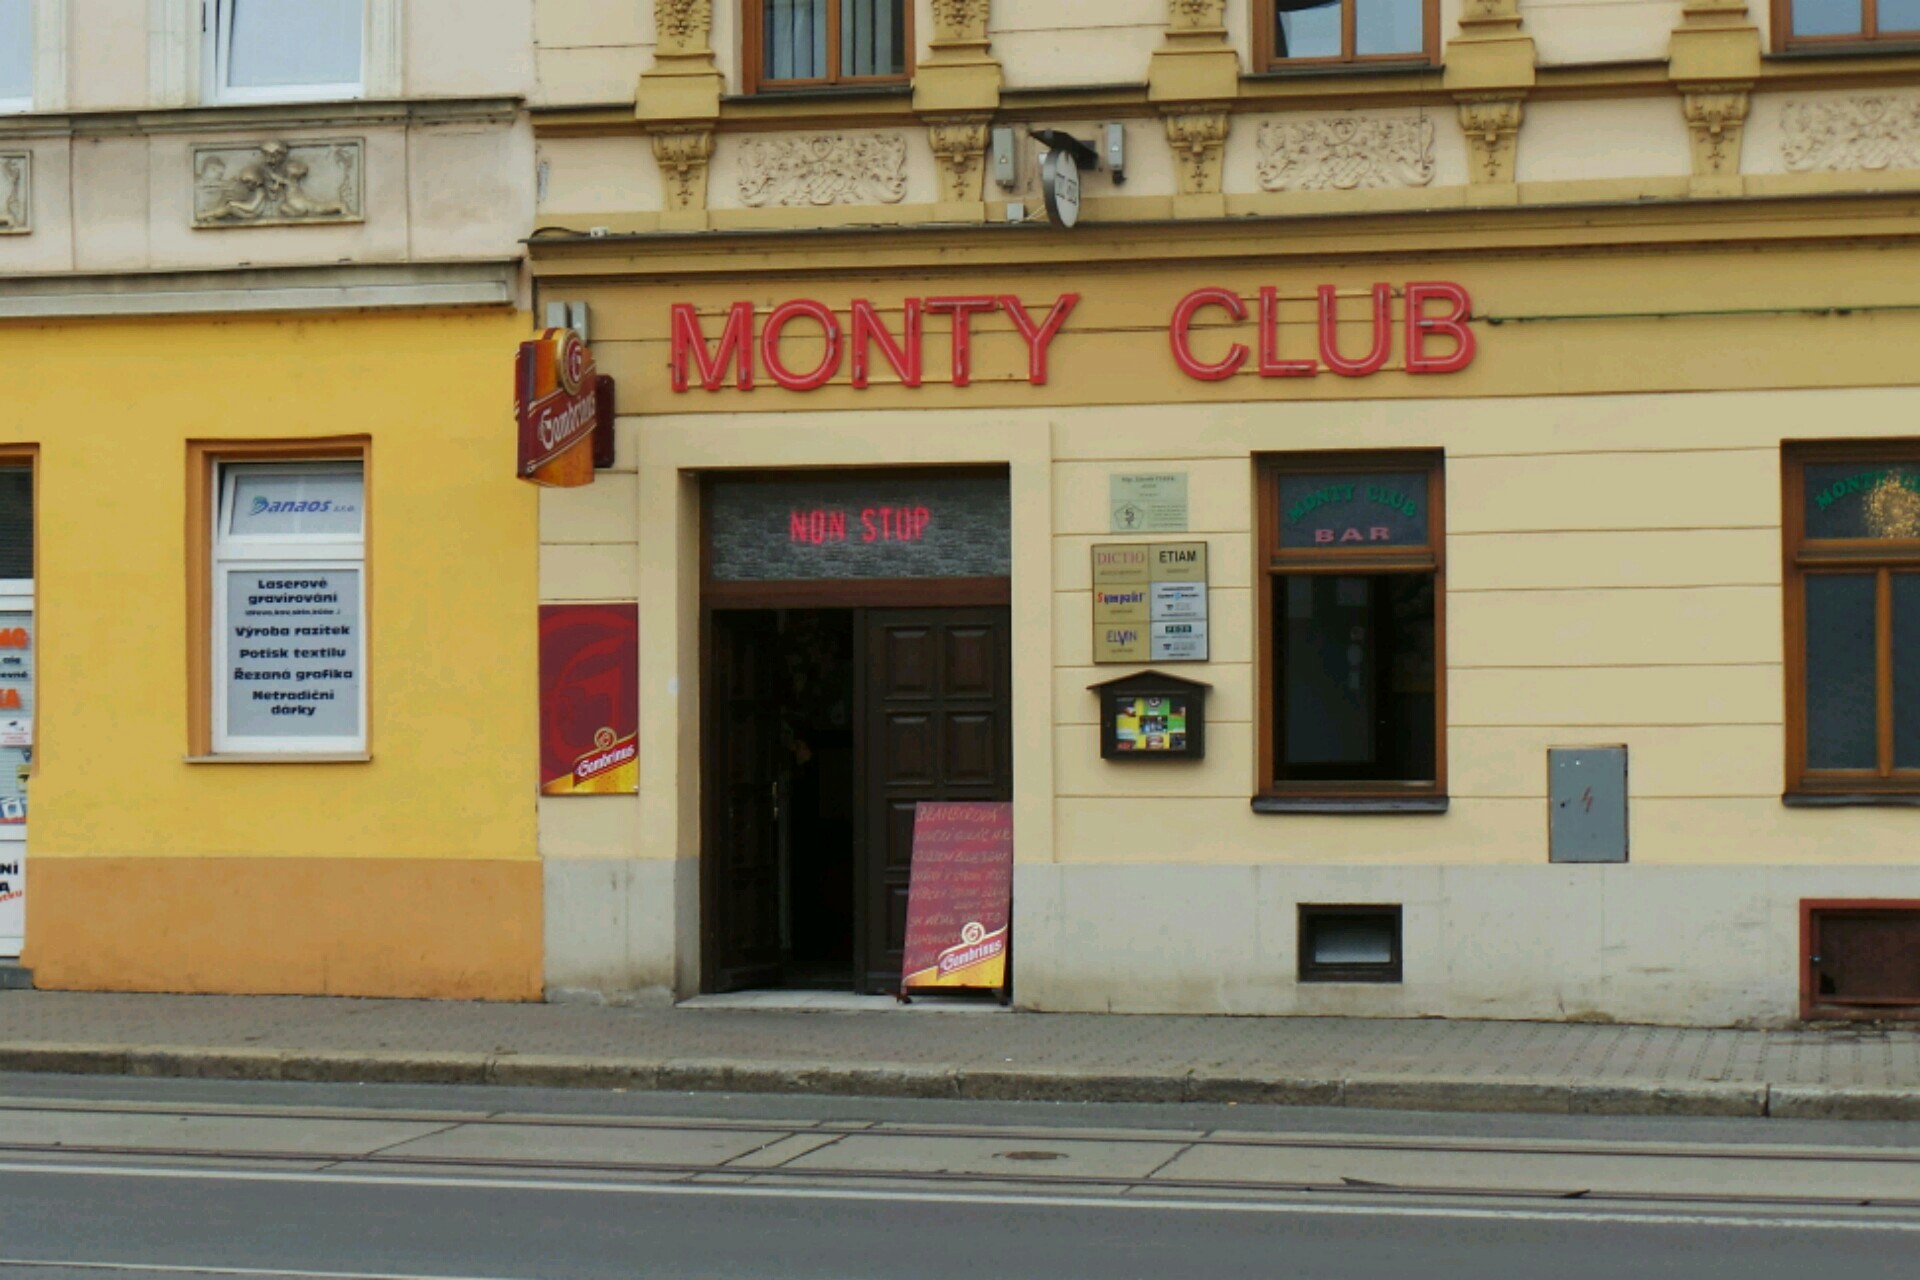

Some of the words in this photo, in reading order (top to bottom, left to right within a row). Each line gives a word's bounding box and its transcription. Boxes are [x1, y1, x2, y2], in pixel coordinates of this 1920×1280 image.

[671, 293, 1080, 392] MONTY
[1170, 281, 1477, 381] CLUB
[1287, 483, 1355, 525] MONTY
[1367, 484, 1416, 517] CLUB
[790, 508, 847, 545] NON
[860, 503, 931, 543] STOP
[1314, 526, 1390, 543] BAR
[1158, 549, 1197, 564] ETIAM
[258, 577, 328, 590] Laserové
[235, 624, 290, 638] Výroba
[294, 624, 350, 636] razítek
[240, 647, 289, 659] Potisk
[293, 647, 346, 659] textilu
[234, 667, 291, 681] Řezaná
[296, 668, 353, 681] grafika
[252, 690, 335, 701] Netradiční
[271, 704, 316, 717] dárky
